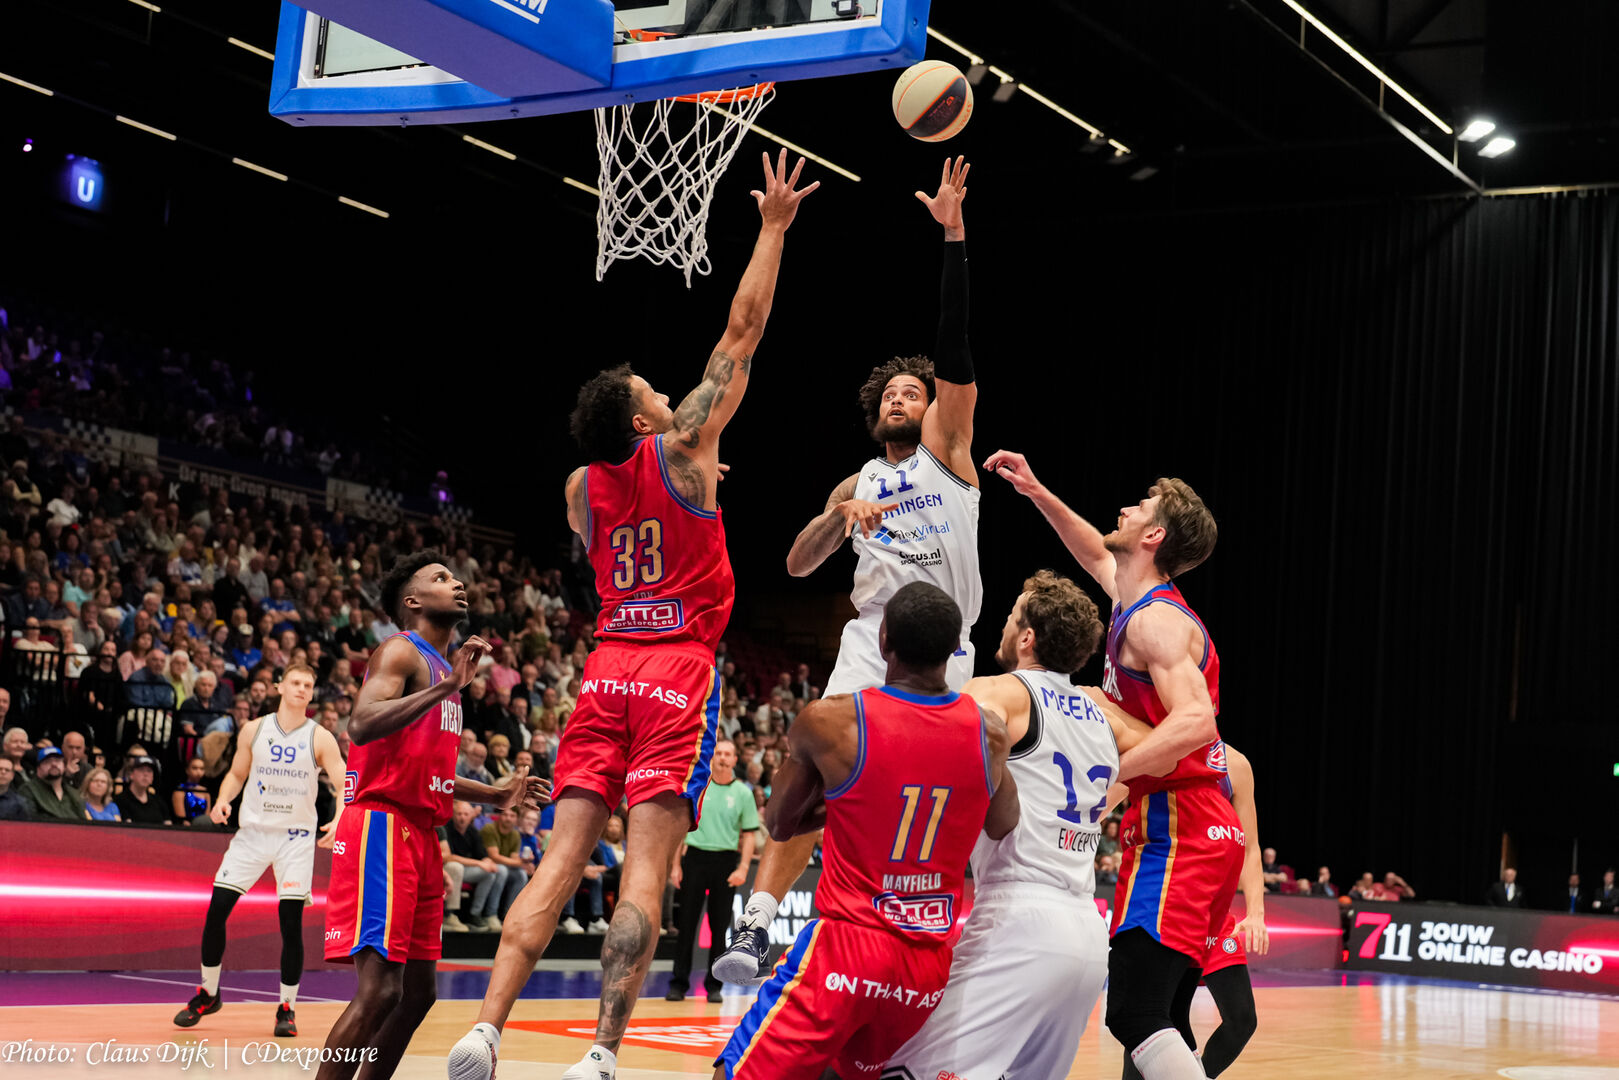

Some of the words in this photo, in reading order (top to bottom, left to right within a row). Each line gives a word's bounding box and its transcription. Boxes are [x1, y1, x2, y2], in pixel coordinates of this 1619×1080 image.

[77, 176, 95, 203] U
[877, 469, 914, 500] 11
[610, 517, 664, 591] 33
[609, 619, 674, 628] workforce.eu
[649, 686, 689, 709] ASS
[270, 745, 297, 764] 99
[1052, 751, 1112, 824] 12
[888, 784, 954, 863] 11
[1207, 825, 1232, 840] ON
[882, 872, 942, 893] MAYFIELD
[1418, 921, 1494, 945] JOUW
[1417, 941, 1506, 967] ONLINE
[1510, 948, 1604, 974] CASINO
[825, 972, 858, 995] ON
[862, 979, 919, 1006] THAT
